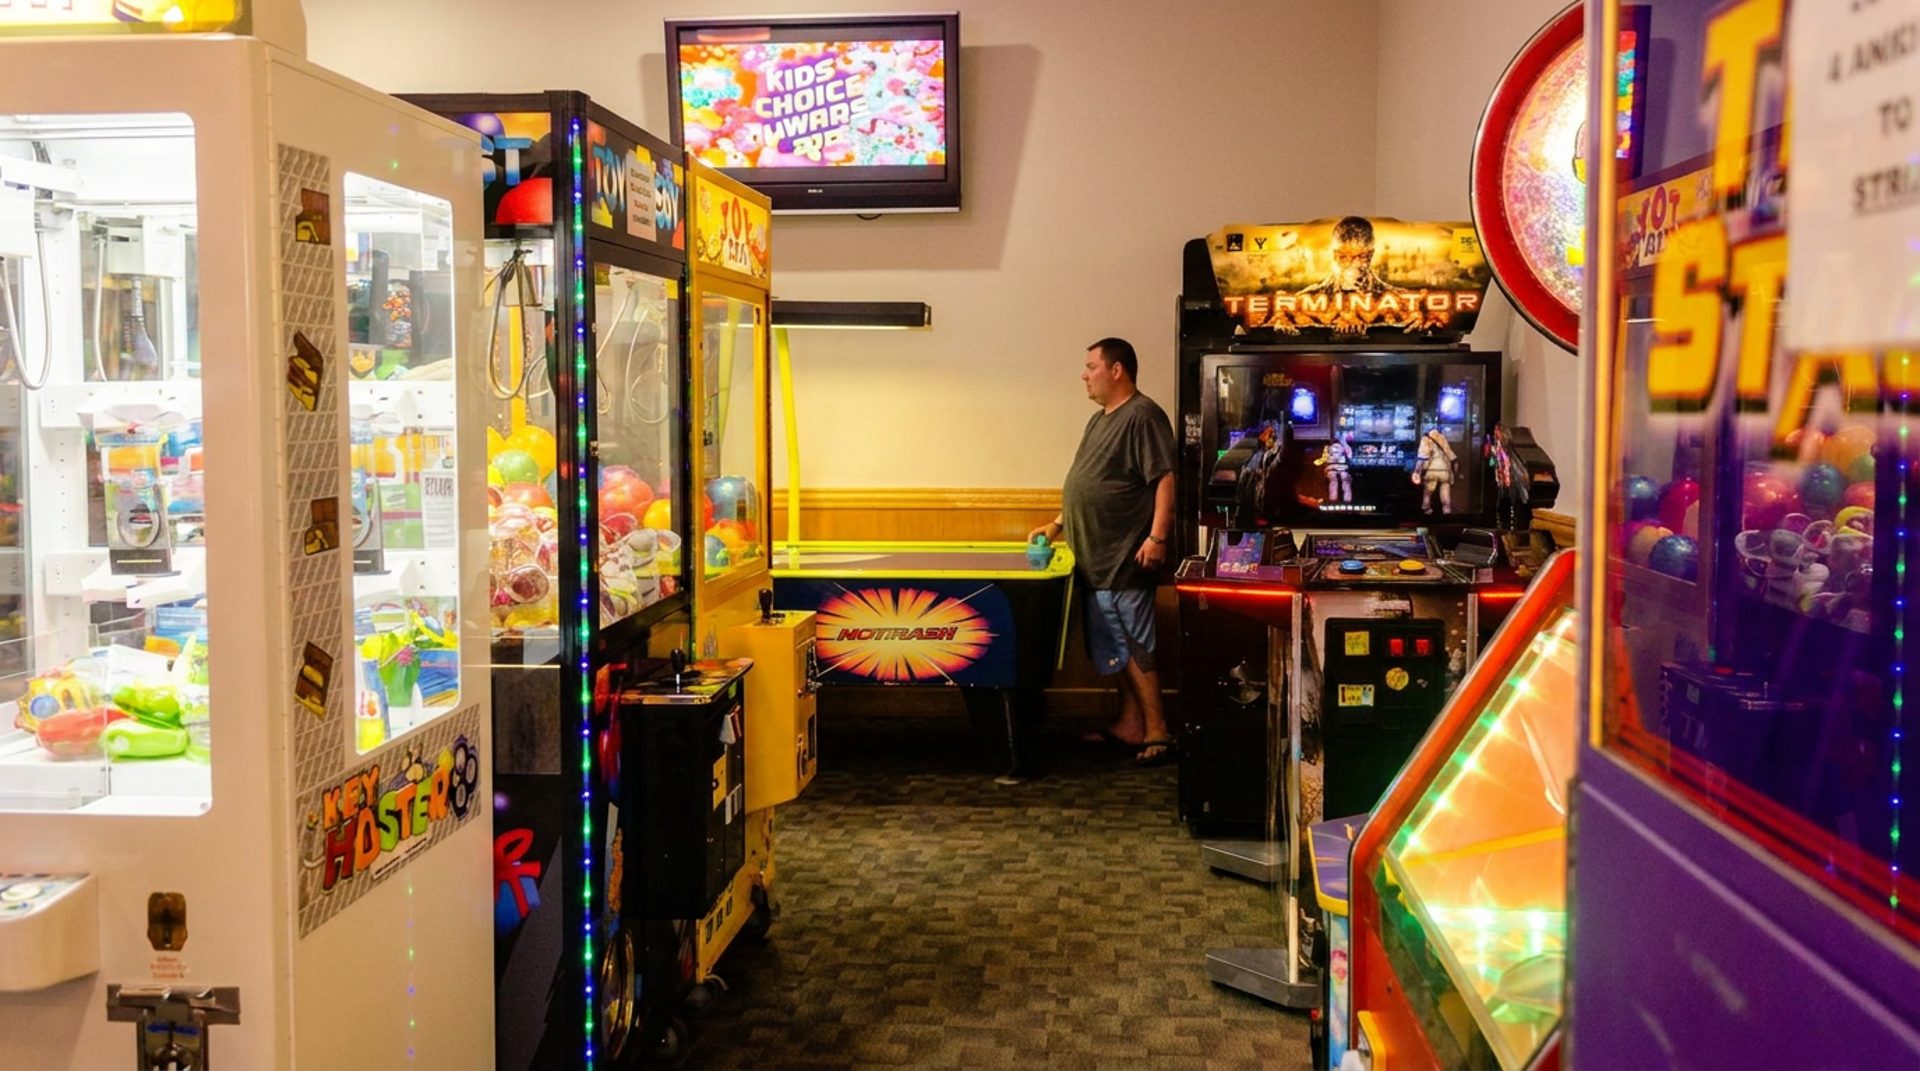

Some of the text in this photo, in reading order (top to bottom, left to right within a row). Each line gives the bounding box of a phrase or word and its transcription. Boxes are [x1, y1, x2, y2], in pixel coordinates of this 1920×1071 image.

[765, 57, 836, 92] KIDS
[755, 73, 864, 120] CHOICE
[1877, 96, 1913, 135] TO
[593, 145, 625, 214] TOY
[1223, 293, 1479, 314] TERMINATOR
[323, 764, 380, 831] KEY
